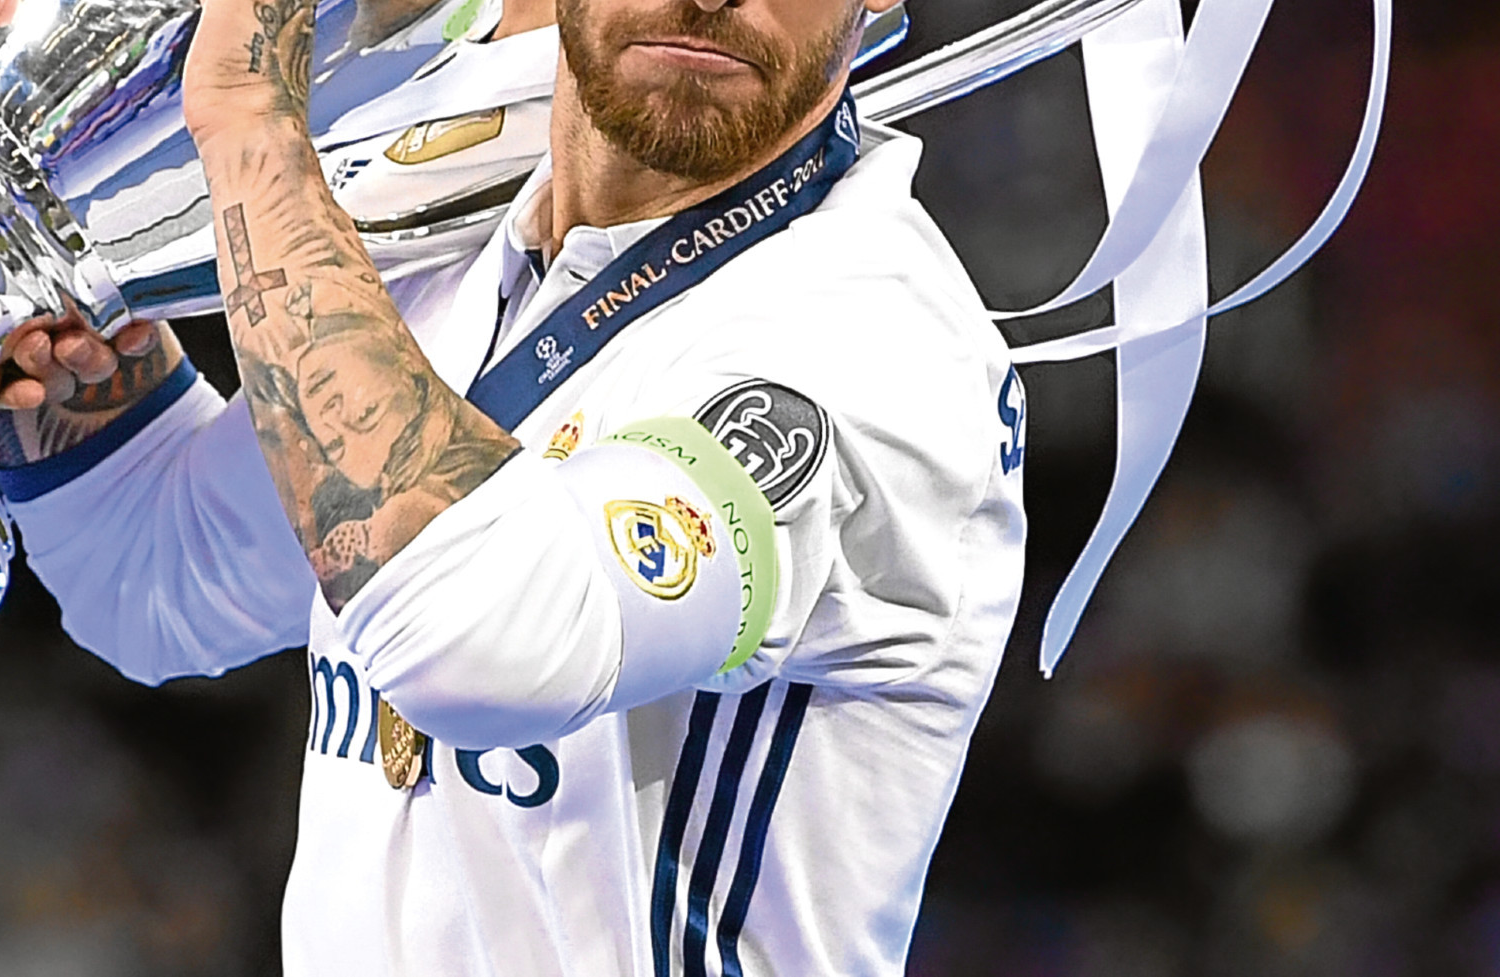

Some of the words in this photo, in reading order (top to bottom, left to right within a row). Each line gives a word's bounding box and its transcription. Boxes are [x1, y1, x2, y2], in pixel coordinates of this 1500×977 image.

[581, 263, 667, 330] FINAL
[671, 178, 792, 264] CARDIFF
[607, 431, 697, 465] ACISM
[722, 501, 749, 555] NO
[741, 562, 754, 612] TO
